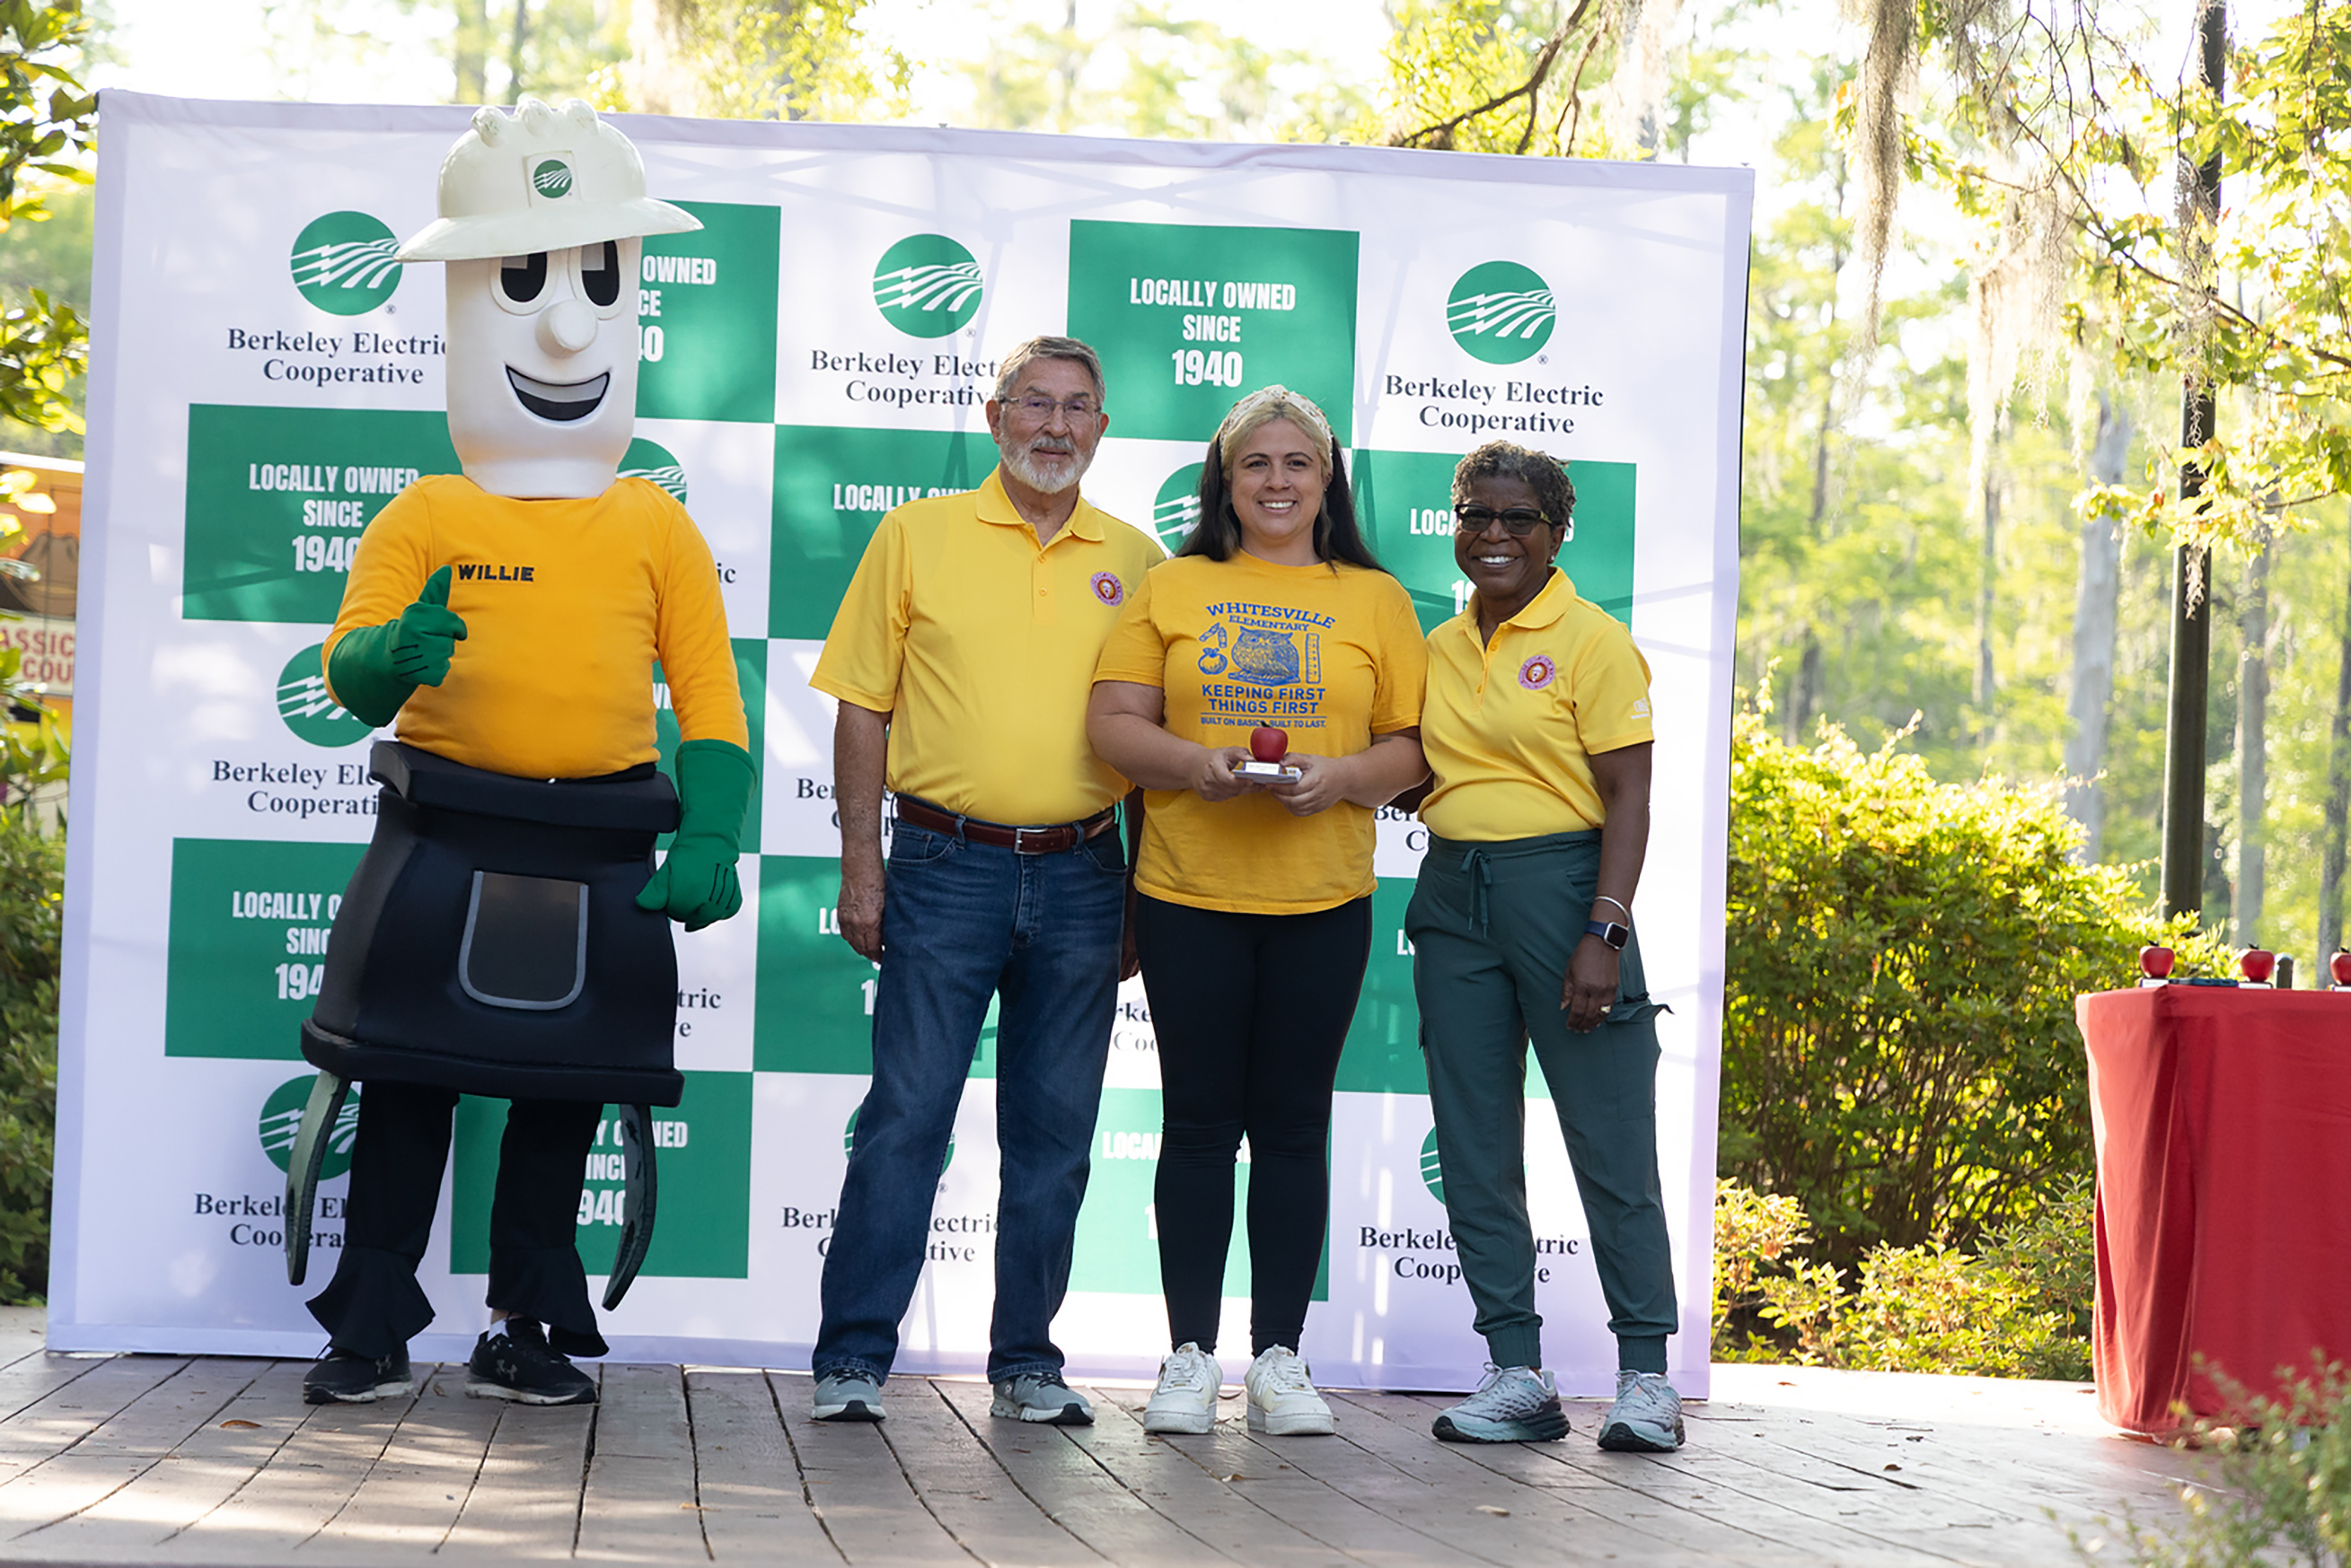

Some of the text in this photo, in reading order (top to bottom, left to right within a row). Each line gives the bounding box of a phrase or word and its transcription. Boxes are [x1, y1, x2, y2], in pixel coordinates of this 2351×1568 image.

[643, 255, 716, 285] OWNED
[1131, 278, 1296, 310] LOCALLY OWNED
[227, 328, 344, 358] Berkeley
[1183, 315, 1241, 342] SINCE
[263, 358, 424, 387] Cooperative
[810, 349, 997, 379] Berkeley Elect
[1172, 350, 1243, 387] 1940
[846, 379, 989, 408] Cooperativ
[1385, 375, 1604, 406] Berkeley Electric
[1419, 405, 1574, 434] Cooperative
[249, 463, 339, 492] LOCALLY
[303, 499, 363, 528] SINCE
[458, 564, 535, 583] WILLIE
[1205, 602, 1336, 629] WHITESVILLE
[1228, 614, 1311, 632] ELEMENTARY
[1202, 684, 1325, 700] KEEPING FIRST
[1208, 698, 1319, 714] THINGS FIRST
[1201, 717, 1222, 725] BUILT
[1223, 717, 1235, 726] ON
[212, 760, 327, 790] Berkeley
[248, 790, 378, 819] Cooperati
[232, 891, 322, 920] LOCALLY
[194, 1193, 286, 1217] Berkel
[1359, 1227, 1457, 1251] Berkele
